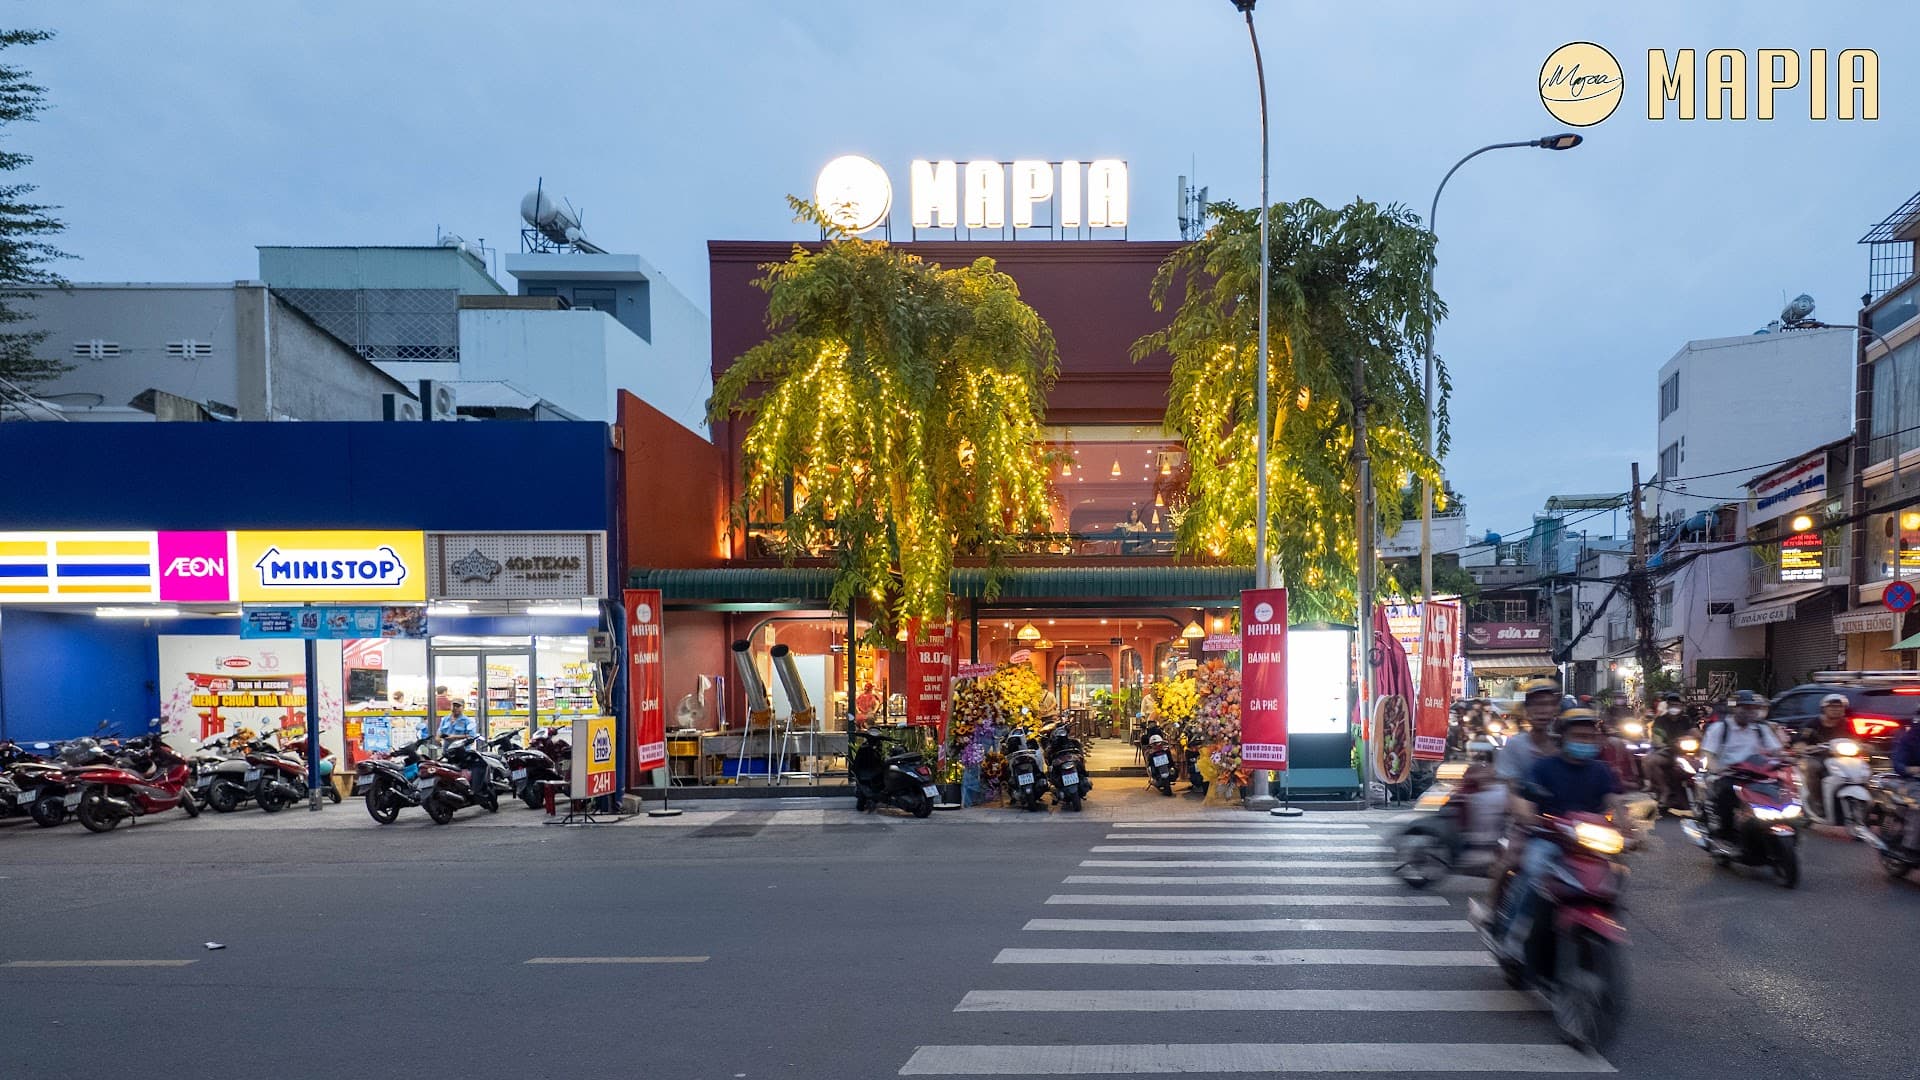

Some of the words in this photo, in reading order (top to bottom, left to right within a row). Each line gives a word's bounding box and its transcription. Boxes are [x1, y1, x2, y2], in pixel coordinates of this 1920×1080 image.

[910, 158, 1129, 229] MAPIA
[271, 560, 395, 580] MINISTOP
[1769, 610, 1784, 620] GIA
[1247, 623, 1281, 636] MAPIA
[1841, 620, 1863, 632] MINH
[1523, 629, 1541, 639] XE
[1247, 650, 1270, 664] BÁNH
[1270, 649, 1281, 664] MÌ
[191, 694, 219, 707] MENU
[258, 692, 279, 707] NHÀ
[1250, 699, 1261, 711] CÀ
[1262, 698, 1278, 711] PHÊ
[597, 737, 608, 746] MINI
[596, 747, 609, 759] STOP
[593, 772, 611, 794] 24H
